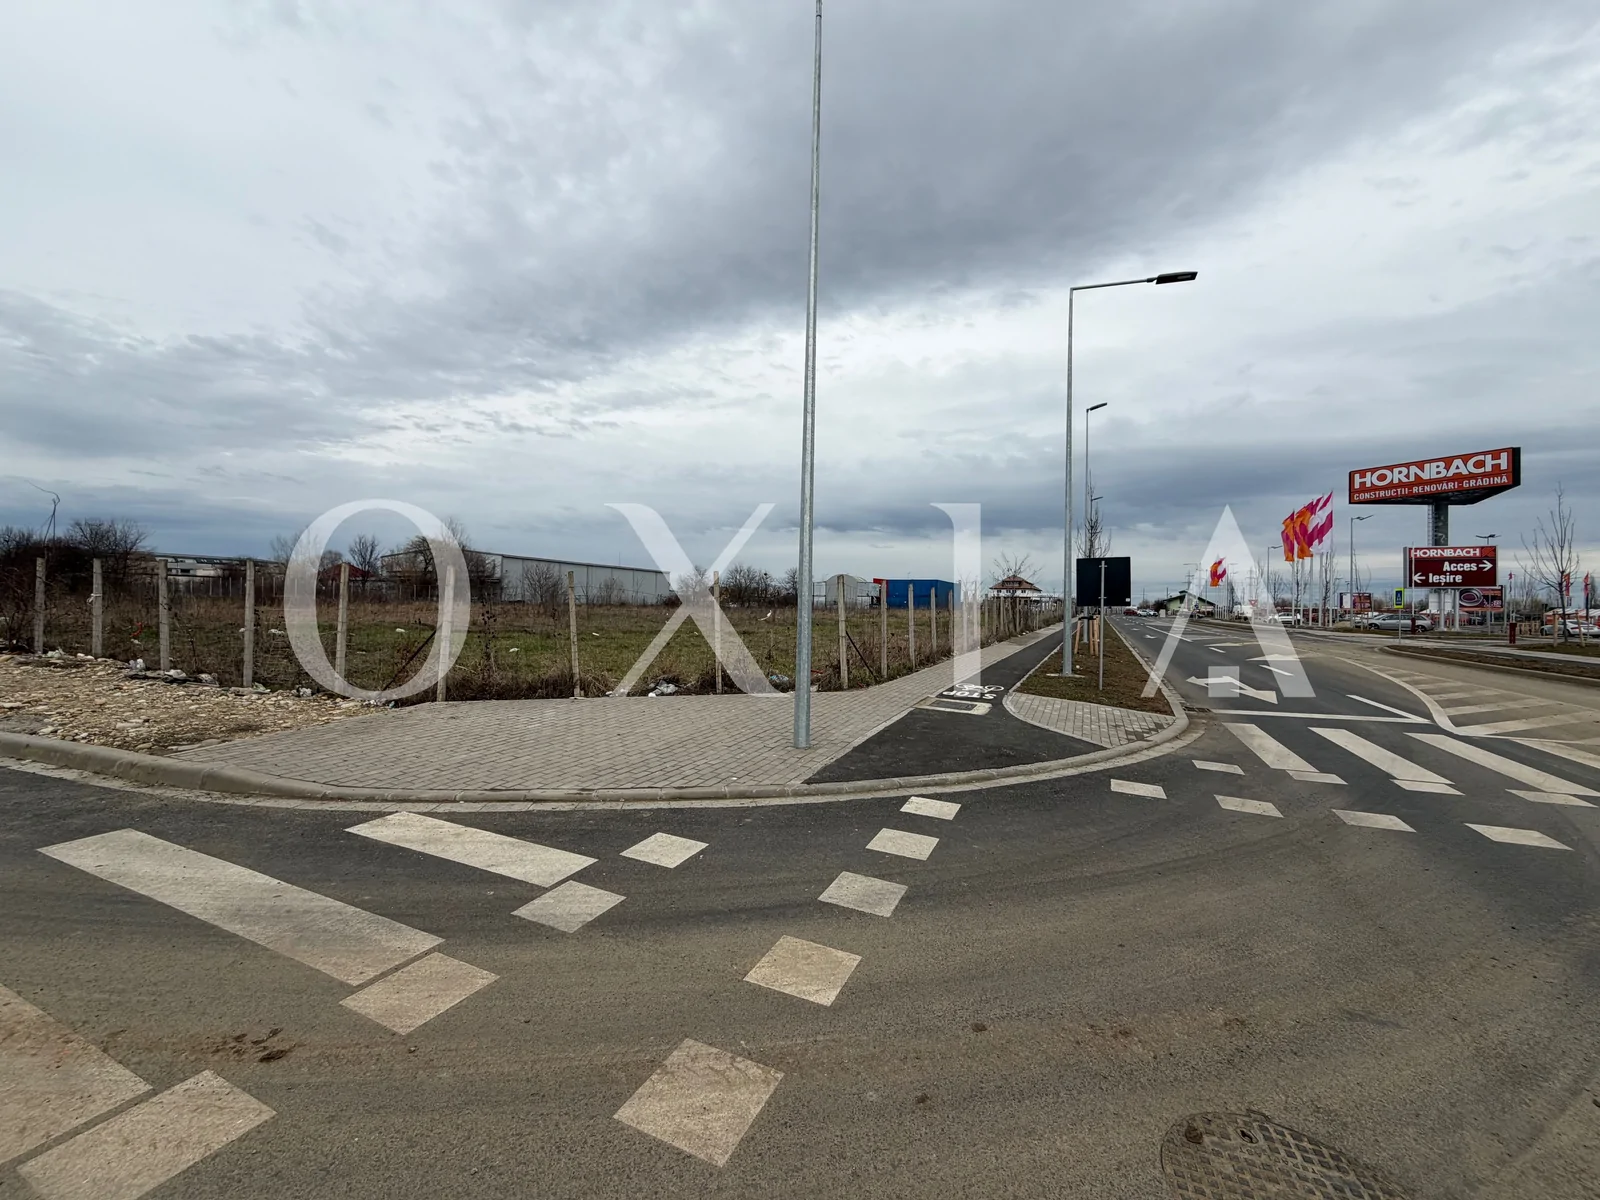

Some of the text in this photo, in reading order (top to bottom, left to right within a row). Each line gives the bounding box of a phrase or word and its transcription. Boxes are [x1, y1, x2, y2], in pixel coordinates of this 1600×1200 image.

[1354, 452, 1508, 489] HORNBACH
[1411, 548, 1480, 557] HORNBACH
[1443, 561, 1477, 571] Acces
[1429, 573, 1462, 586] Ieșire
[942, 690, 997, 699] STOP
